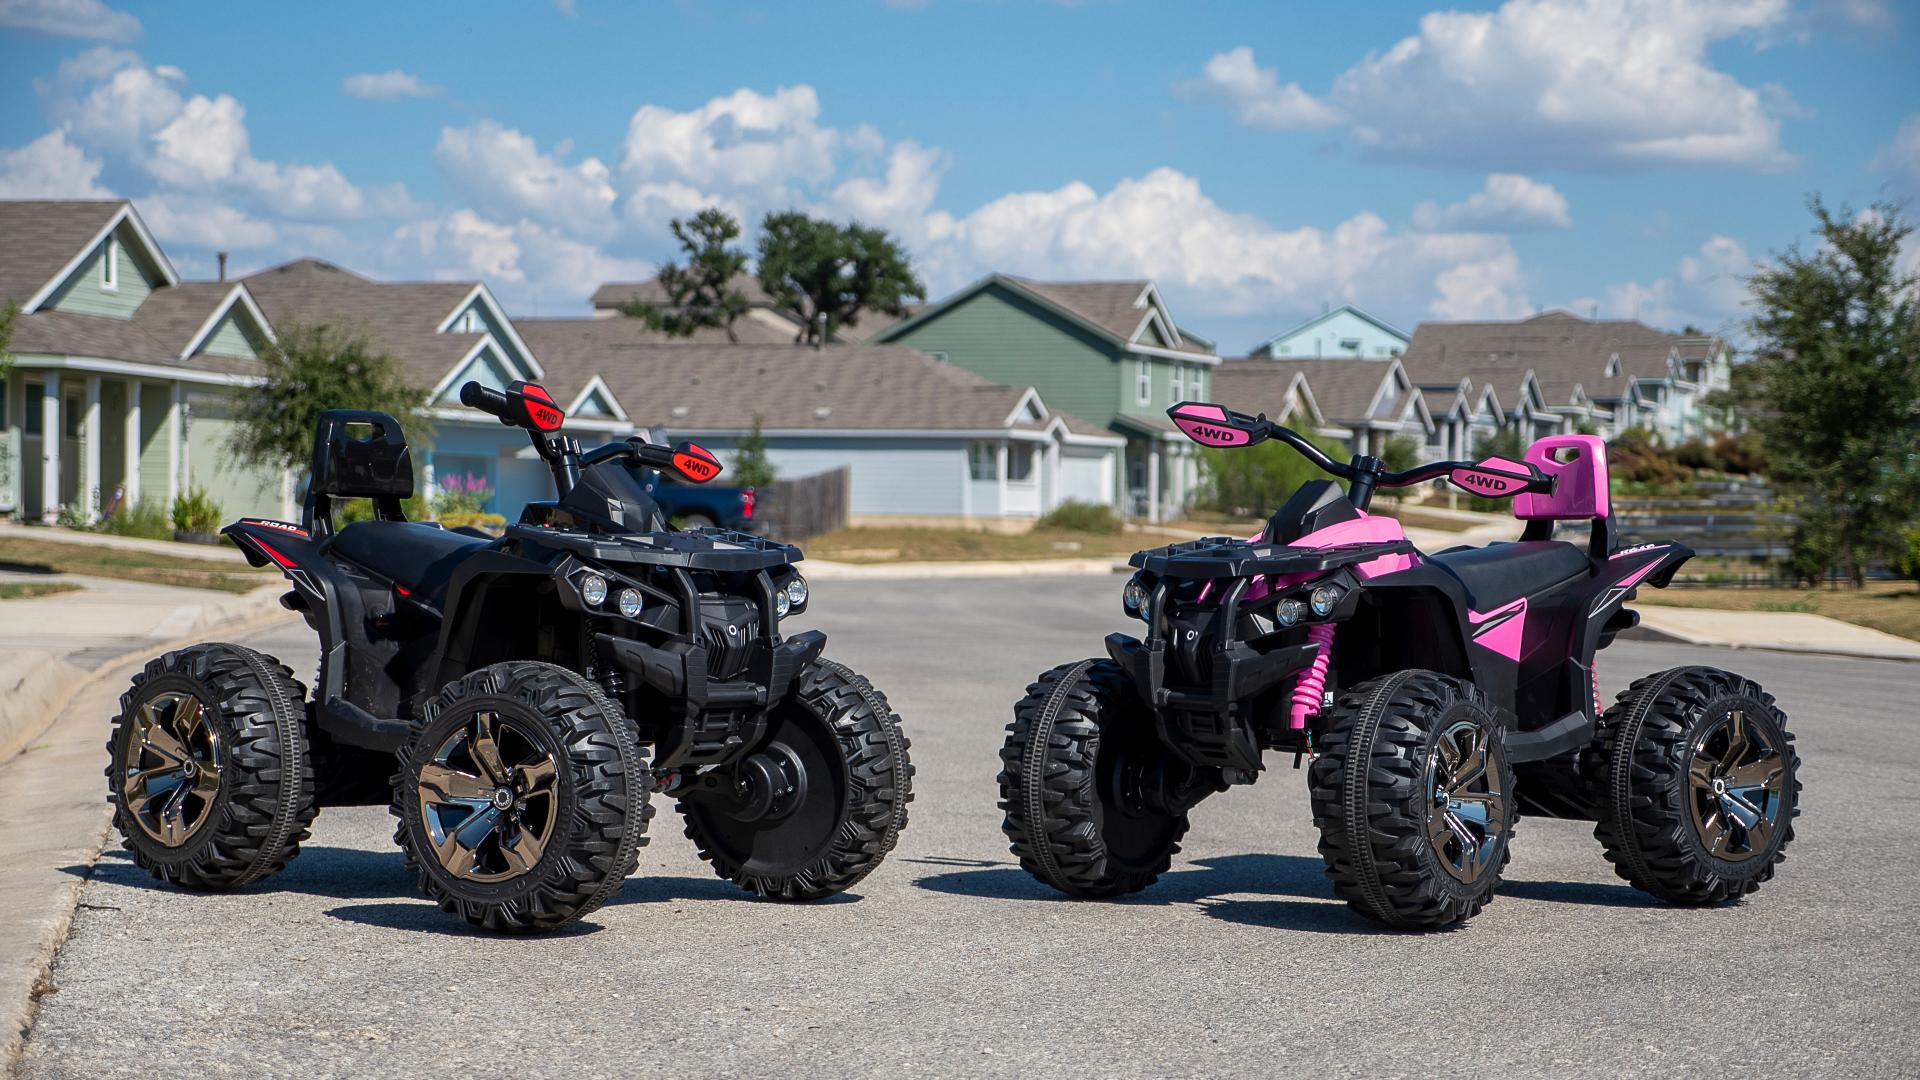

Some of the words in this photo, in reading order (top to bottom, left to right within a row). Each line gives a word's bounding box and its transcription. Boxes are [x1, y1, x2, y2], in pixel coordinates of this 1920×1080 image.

[535, 408, 558, 425] 4WD
[1192, 426, 1234, 442] 4WD
[683, 459, 709, 477] 4WD
[1465, 474, 1507, 491] 4WD
[260, 520, 297, 531] ROAD
